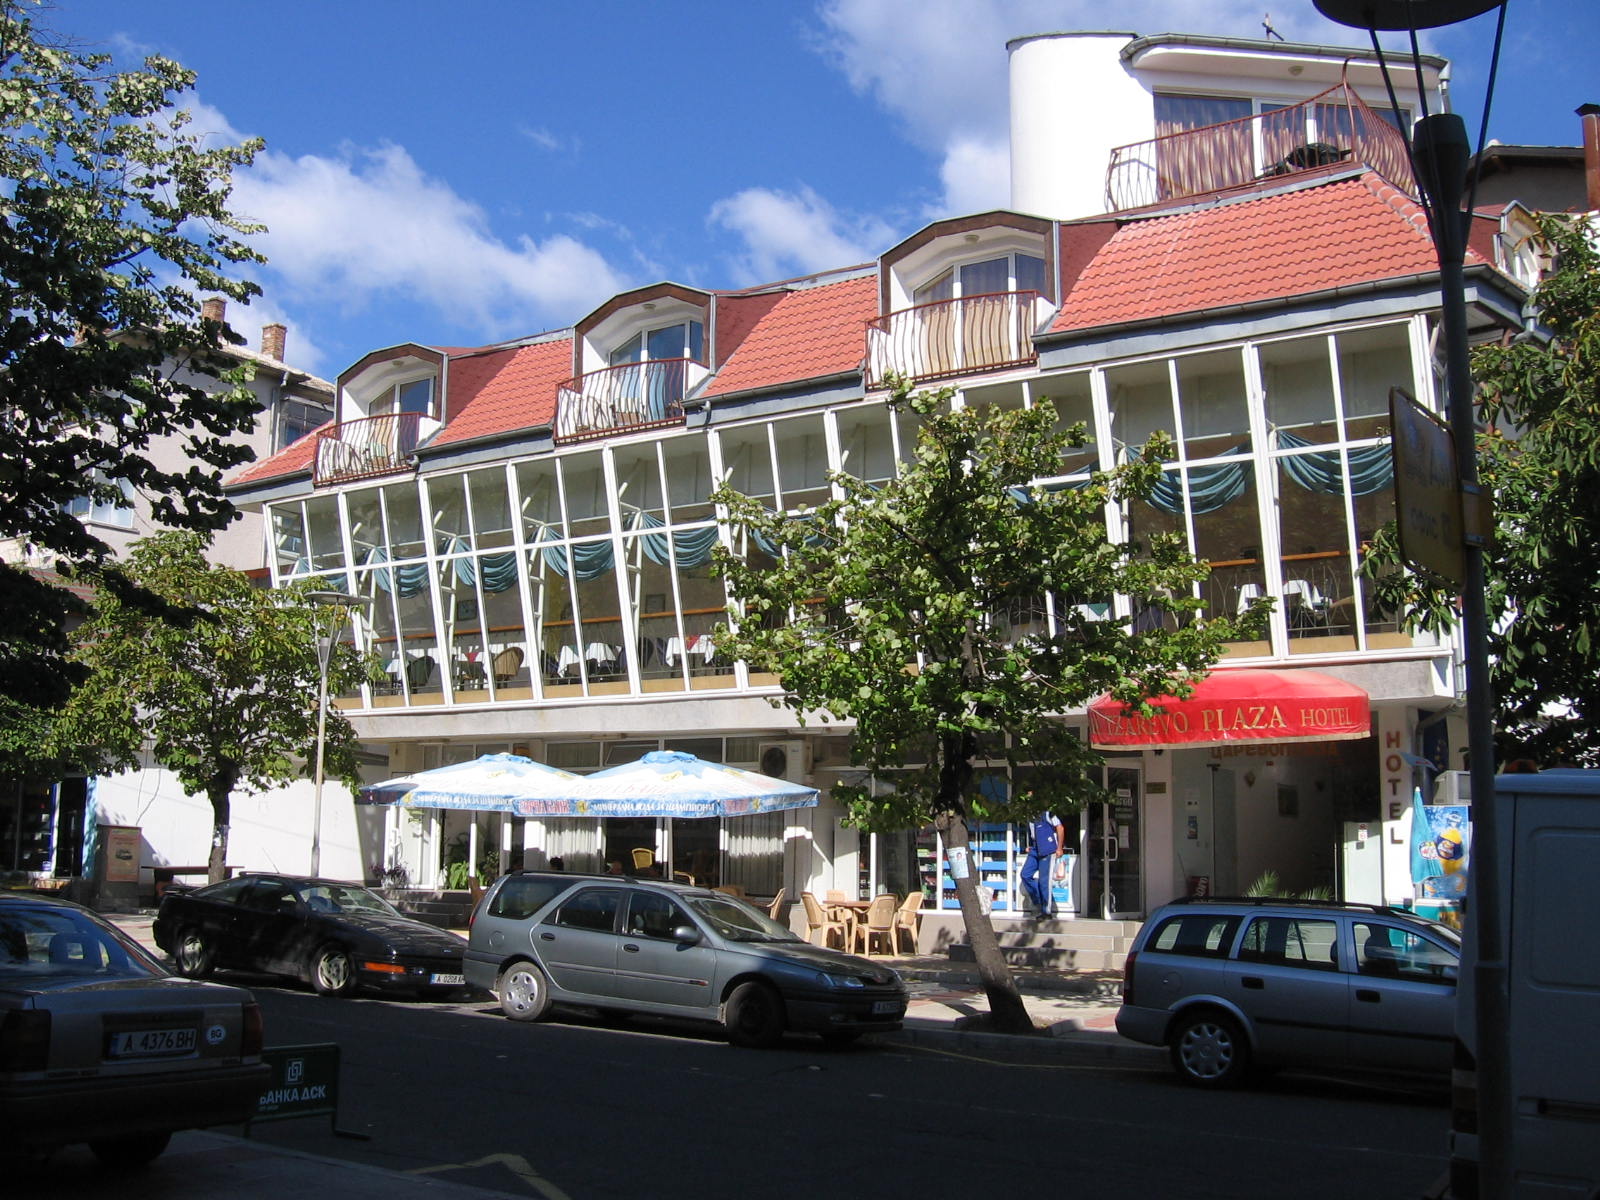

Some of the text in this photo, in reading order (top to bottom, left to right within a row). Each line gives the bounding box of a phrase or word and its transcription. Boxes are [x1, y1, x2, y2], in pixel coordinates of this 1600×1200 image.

[1201, 705, 1287, 732] PLAZA
[1301, 707, 1353, 727] HOTEL
[1385, 731, 1404, 844] HOTEL
[210, 1029, 223, 1039] BG
[301, 1085, 327, 1101] ДСК
